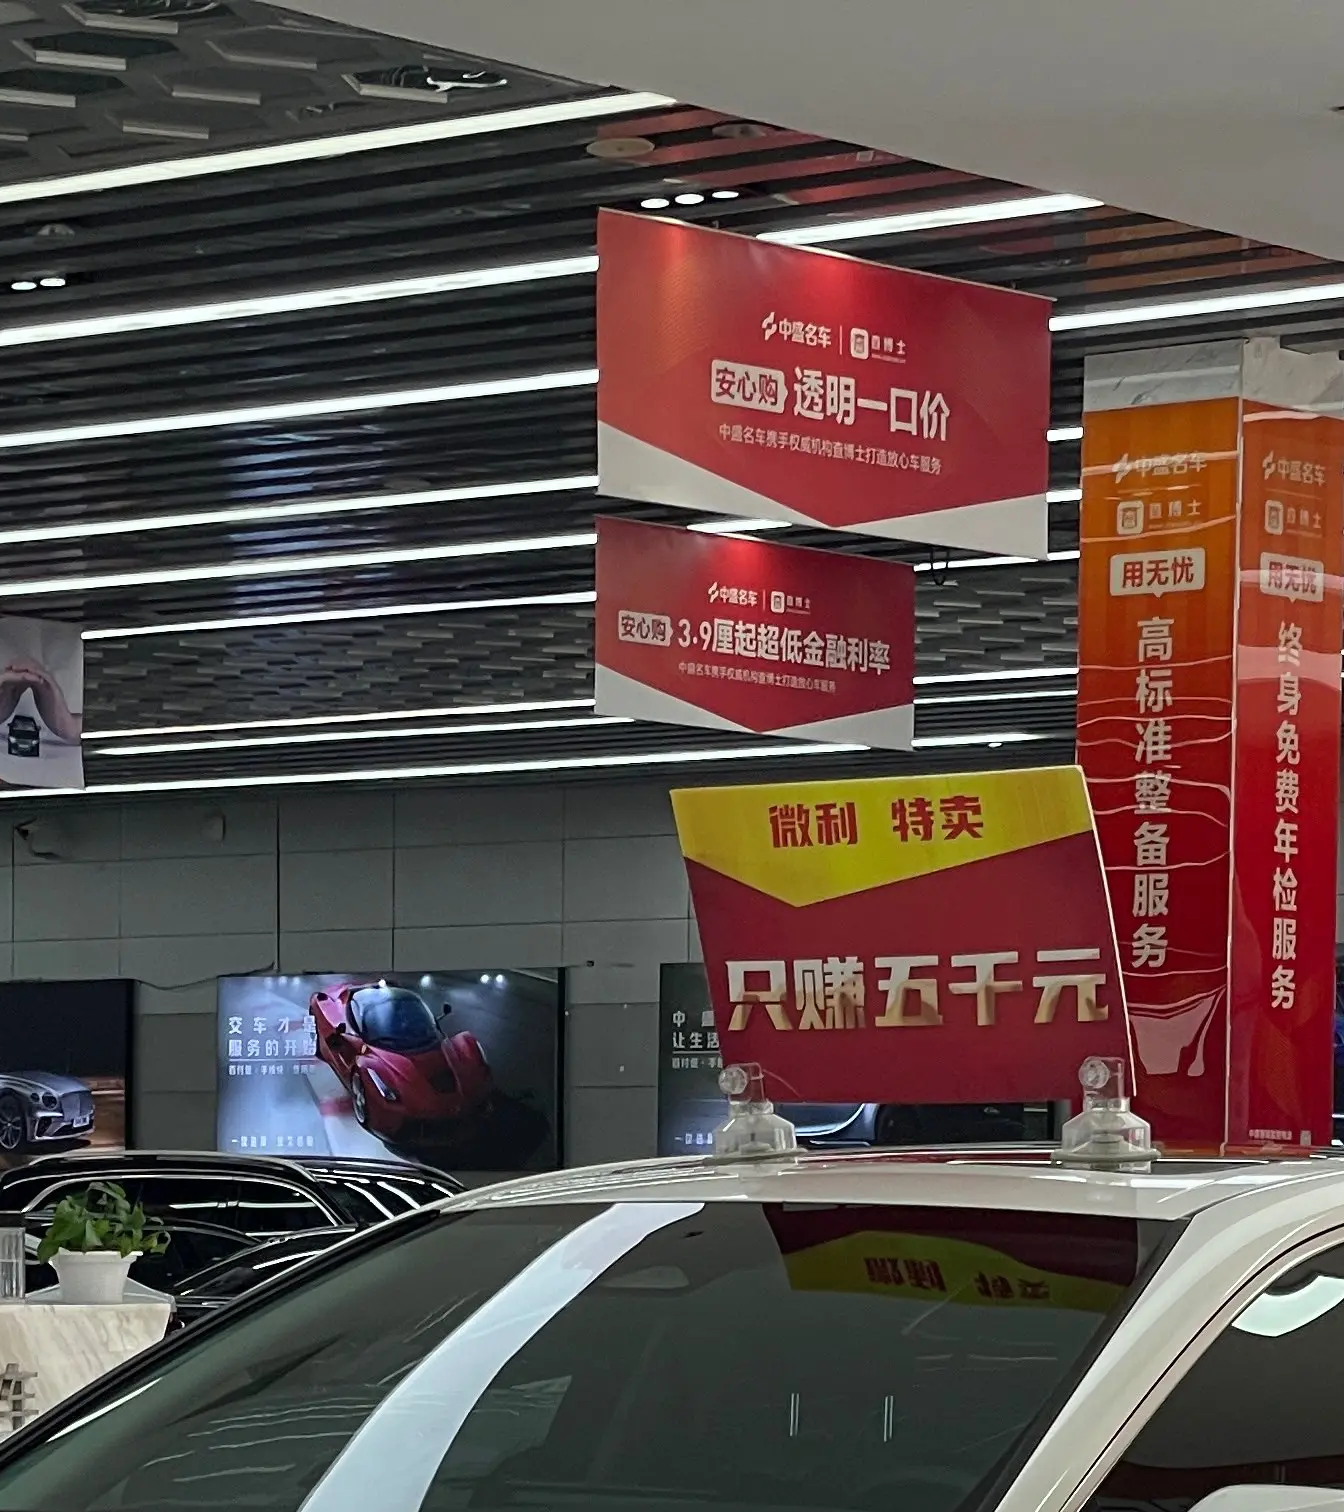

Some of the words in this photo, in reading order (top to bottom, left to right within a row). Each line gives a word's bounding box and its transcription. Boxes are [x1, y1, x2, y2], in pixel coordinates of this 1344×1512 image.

[778, 317, 832, 349] 中盛名车
[715, 366, 778, 407] 安心购
[793, 366, 951, 442] 透明一口价
[1122, 555, 1195, 589] 用无忧
[1267, 560, 1318, 595] 用无忧
[620, 614, 668, 643] 安心购
[1131, 616, 1174, 969] 高标准整备服务
[1271, 620, 1303, 1010] 终身免费年检服务
[768, 800, 859, 849] 微利
[890, 794, 985, 844] 特卖
[725, 947, 1111, 1033] 只赚五千元
[228, 1015, 317, 1036] 交车才是
